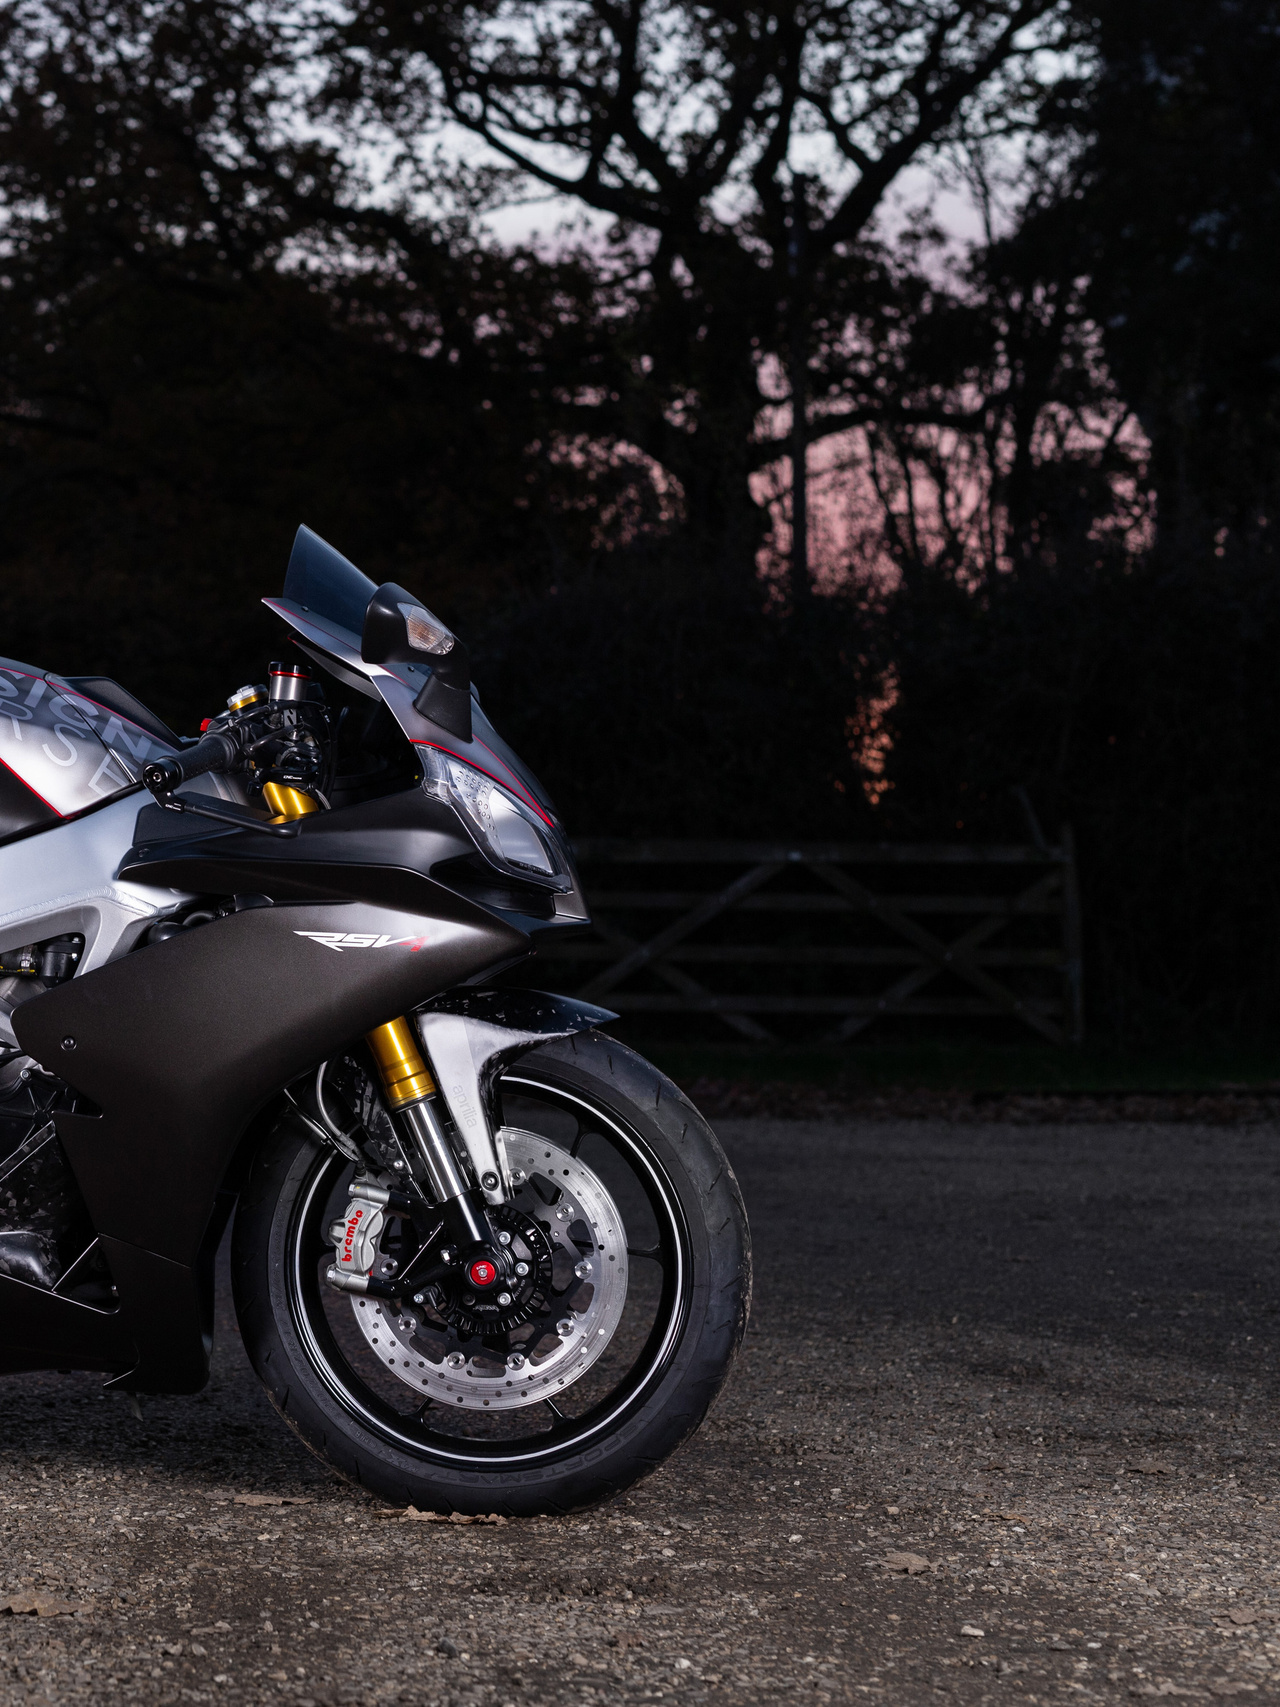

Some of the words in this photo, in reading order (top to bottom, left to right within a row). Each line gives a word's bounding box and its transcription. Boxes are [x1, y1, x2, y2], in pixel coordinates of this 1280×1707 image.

[293, 930, 430, 952] RSV4
[453, 1084, 478, 1129] aprilia
[341, 1210, 364, 1262] brembo
